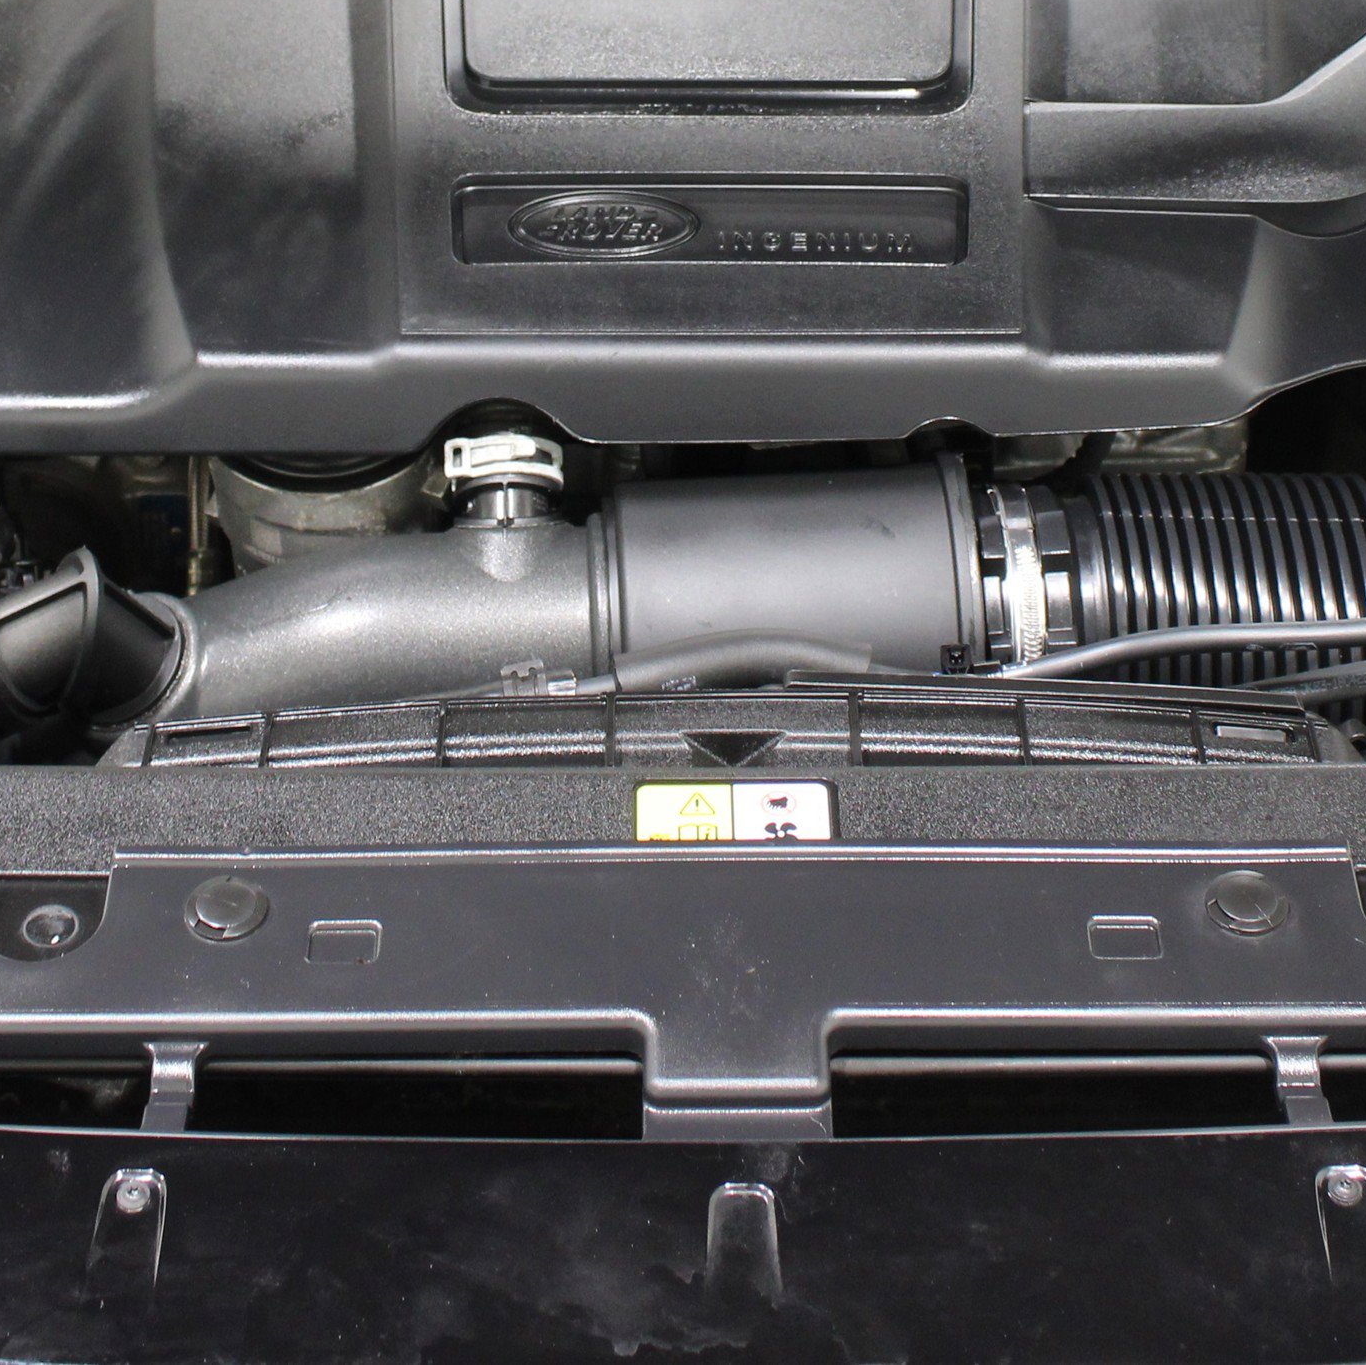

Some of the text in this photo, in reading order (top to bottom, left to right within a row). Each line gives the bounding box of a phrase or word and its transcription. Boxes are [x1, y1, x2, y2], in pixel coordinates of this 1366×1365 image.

[550, 205, 638, 221] LAND
[556, 221, 664, 242] ROVER
[717, 230, 914, 254] INGENIUM
